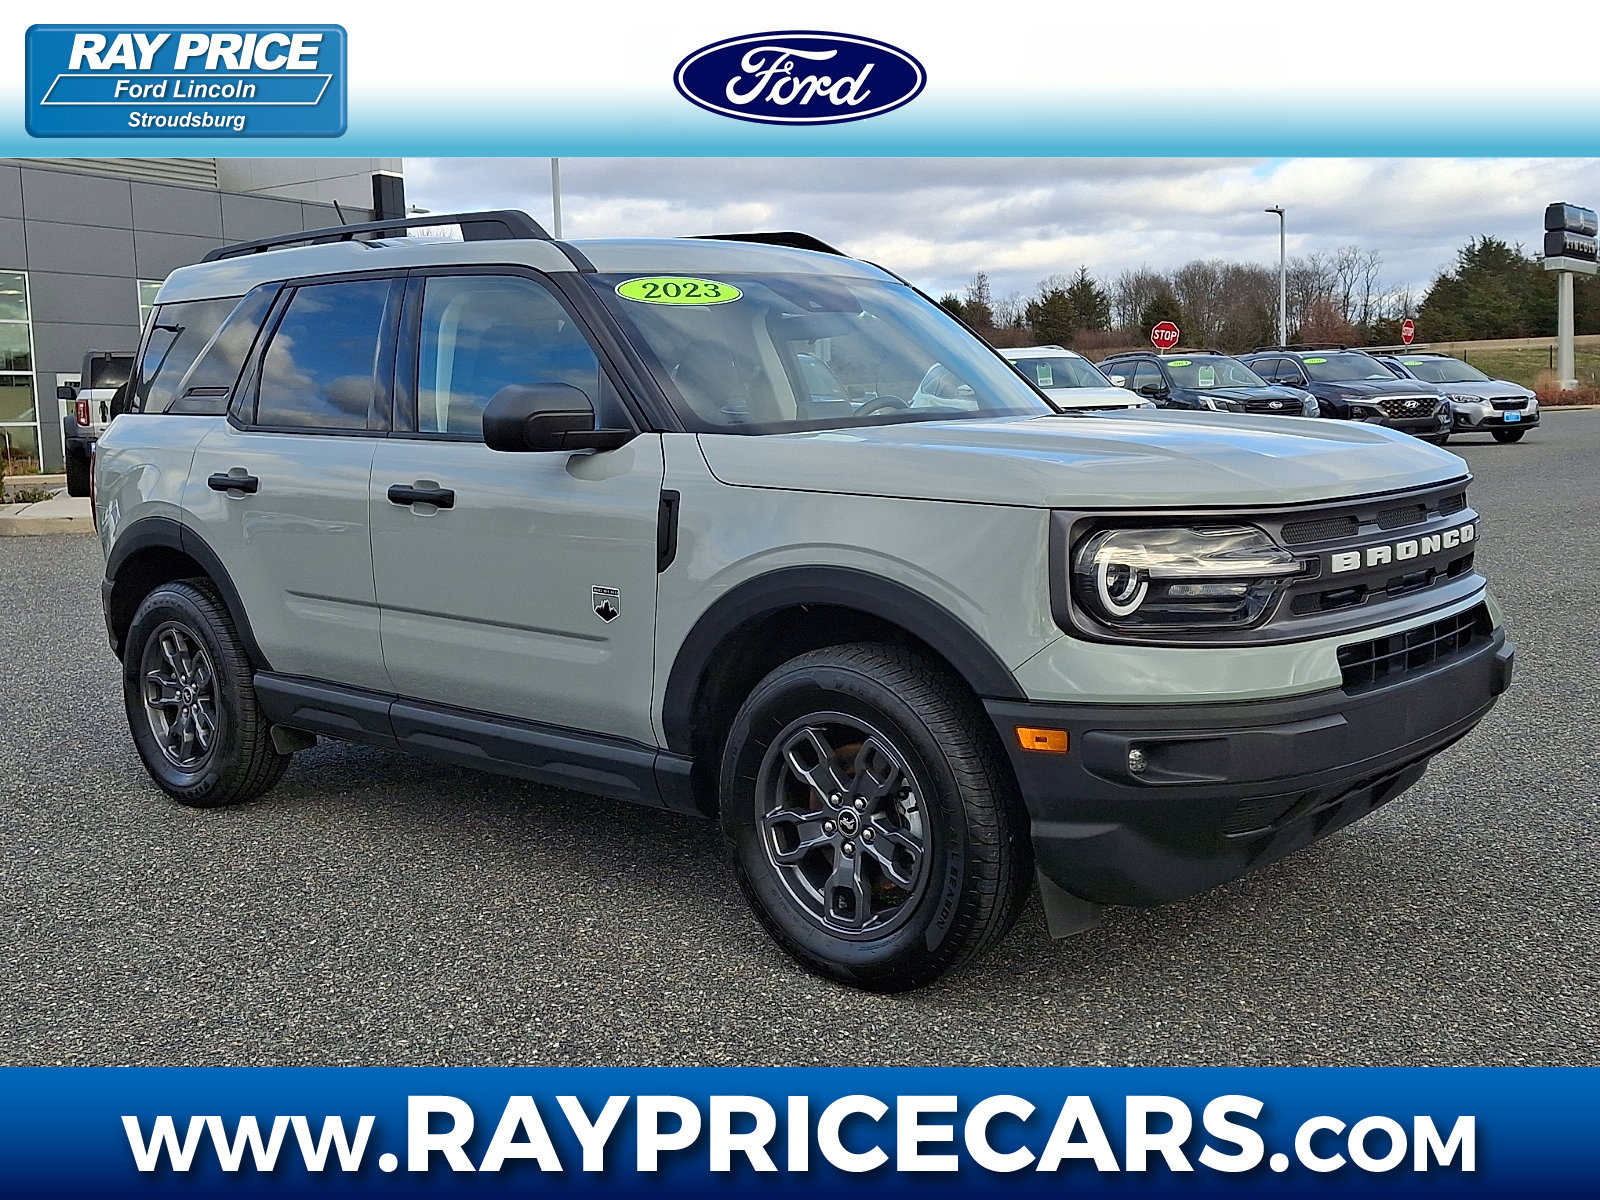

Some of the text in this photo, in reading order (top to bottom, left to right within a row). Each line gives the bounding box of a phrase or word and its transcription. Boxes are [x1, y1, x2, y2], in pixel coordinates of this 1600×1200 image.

[641, 282, 721, 298] 2023
[1153, 329, 1178, 341] STOP
[1331, 524, 1474, 573] BRONCO
